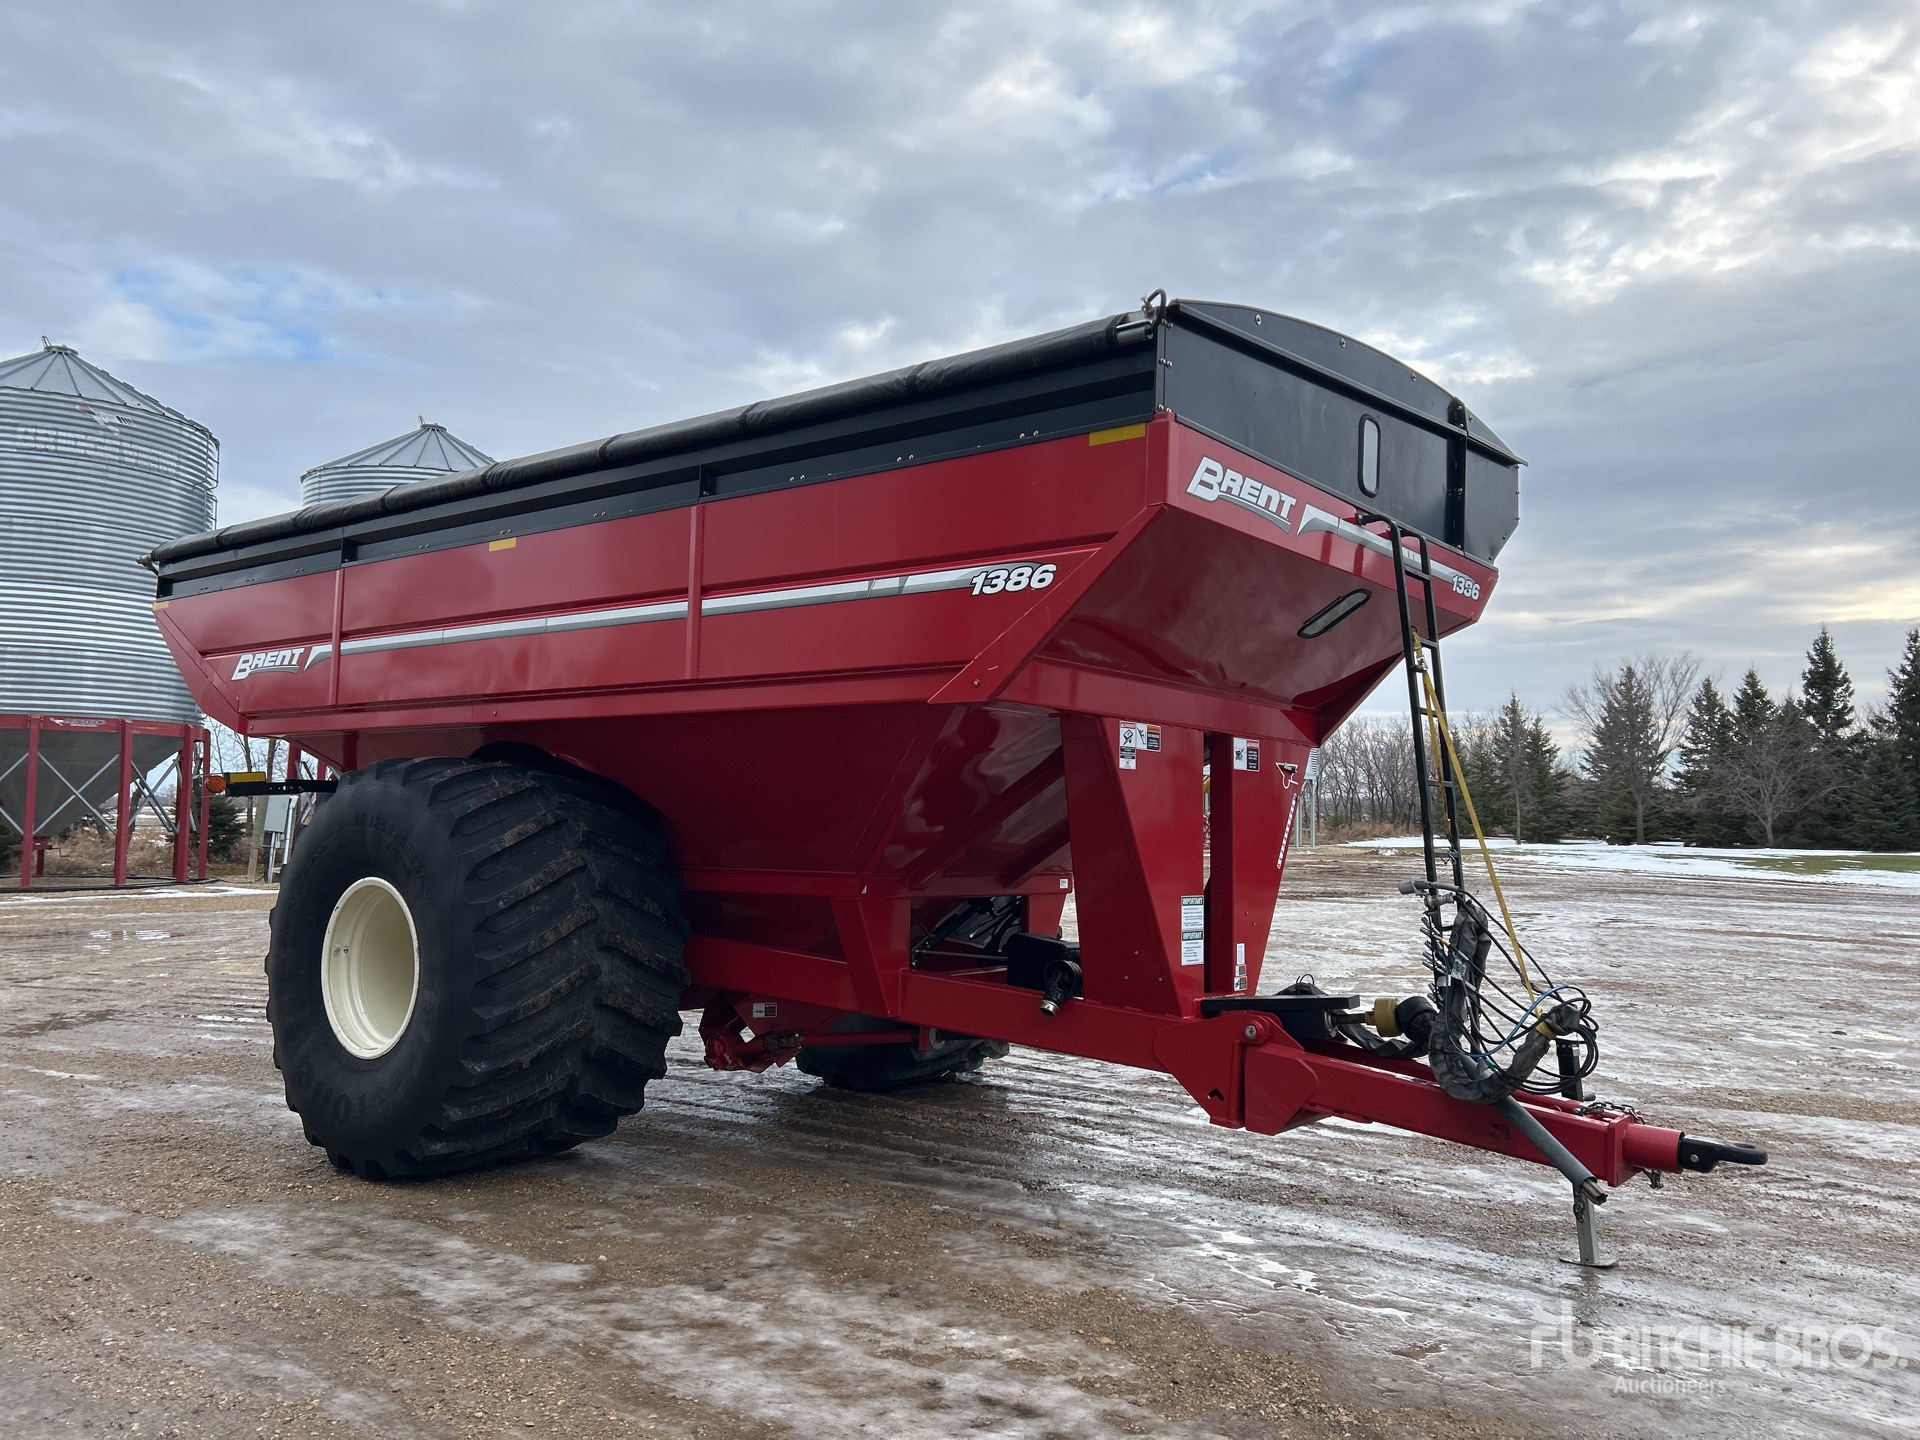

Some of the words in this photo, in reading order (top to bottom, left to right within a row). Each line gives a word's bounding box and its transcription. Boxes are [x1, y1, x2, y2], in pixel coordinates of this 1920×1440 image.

[1186, 456, 1297, 523] BRENT
[971, 563, 1057, 596] 1386
[1452, 574, 1480, 601] 1386
[231, 648, 305, 681] BRENT
